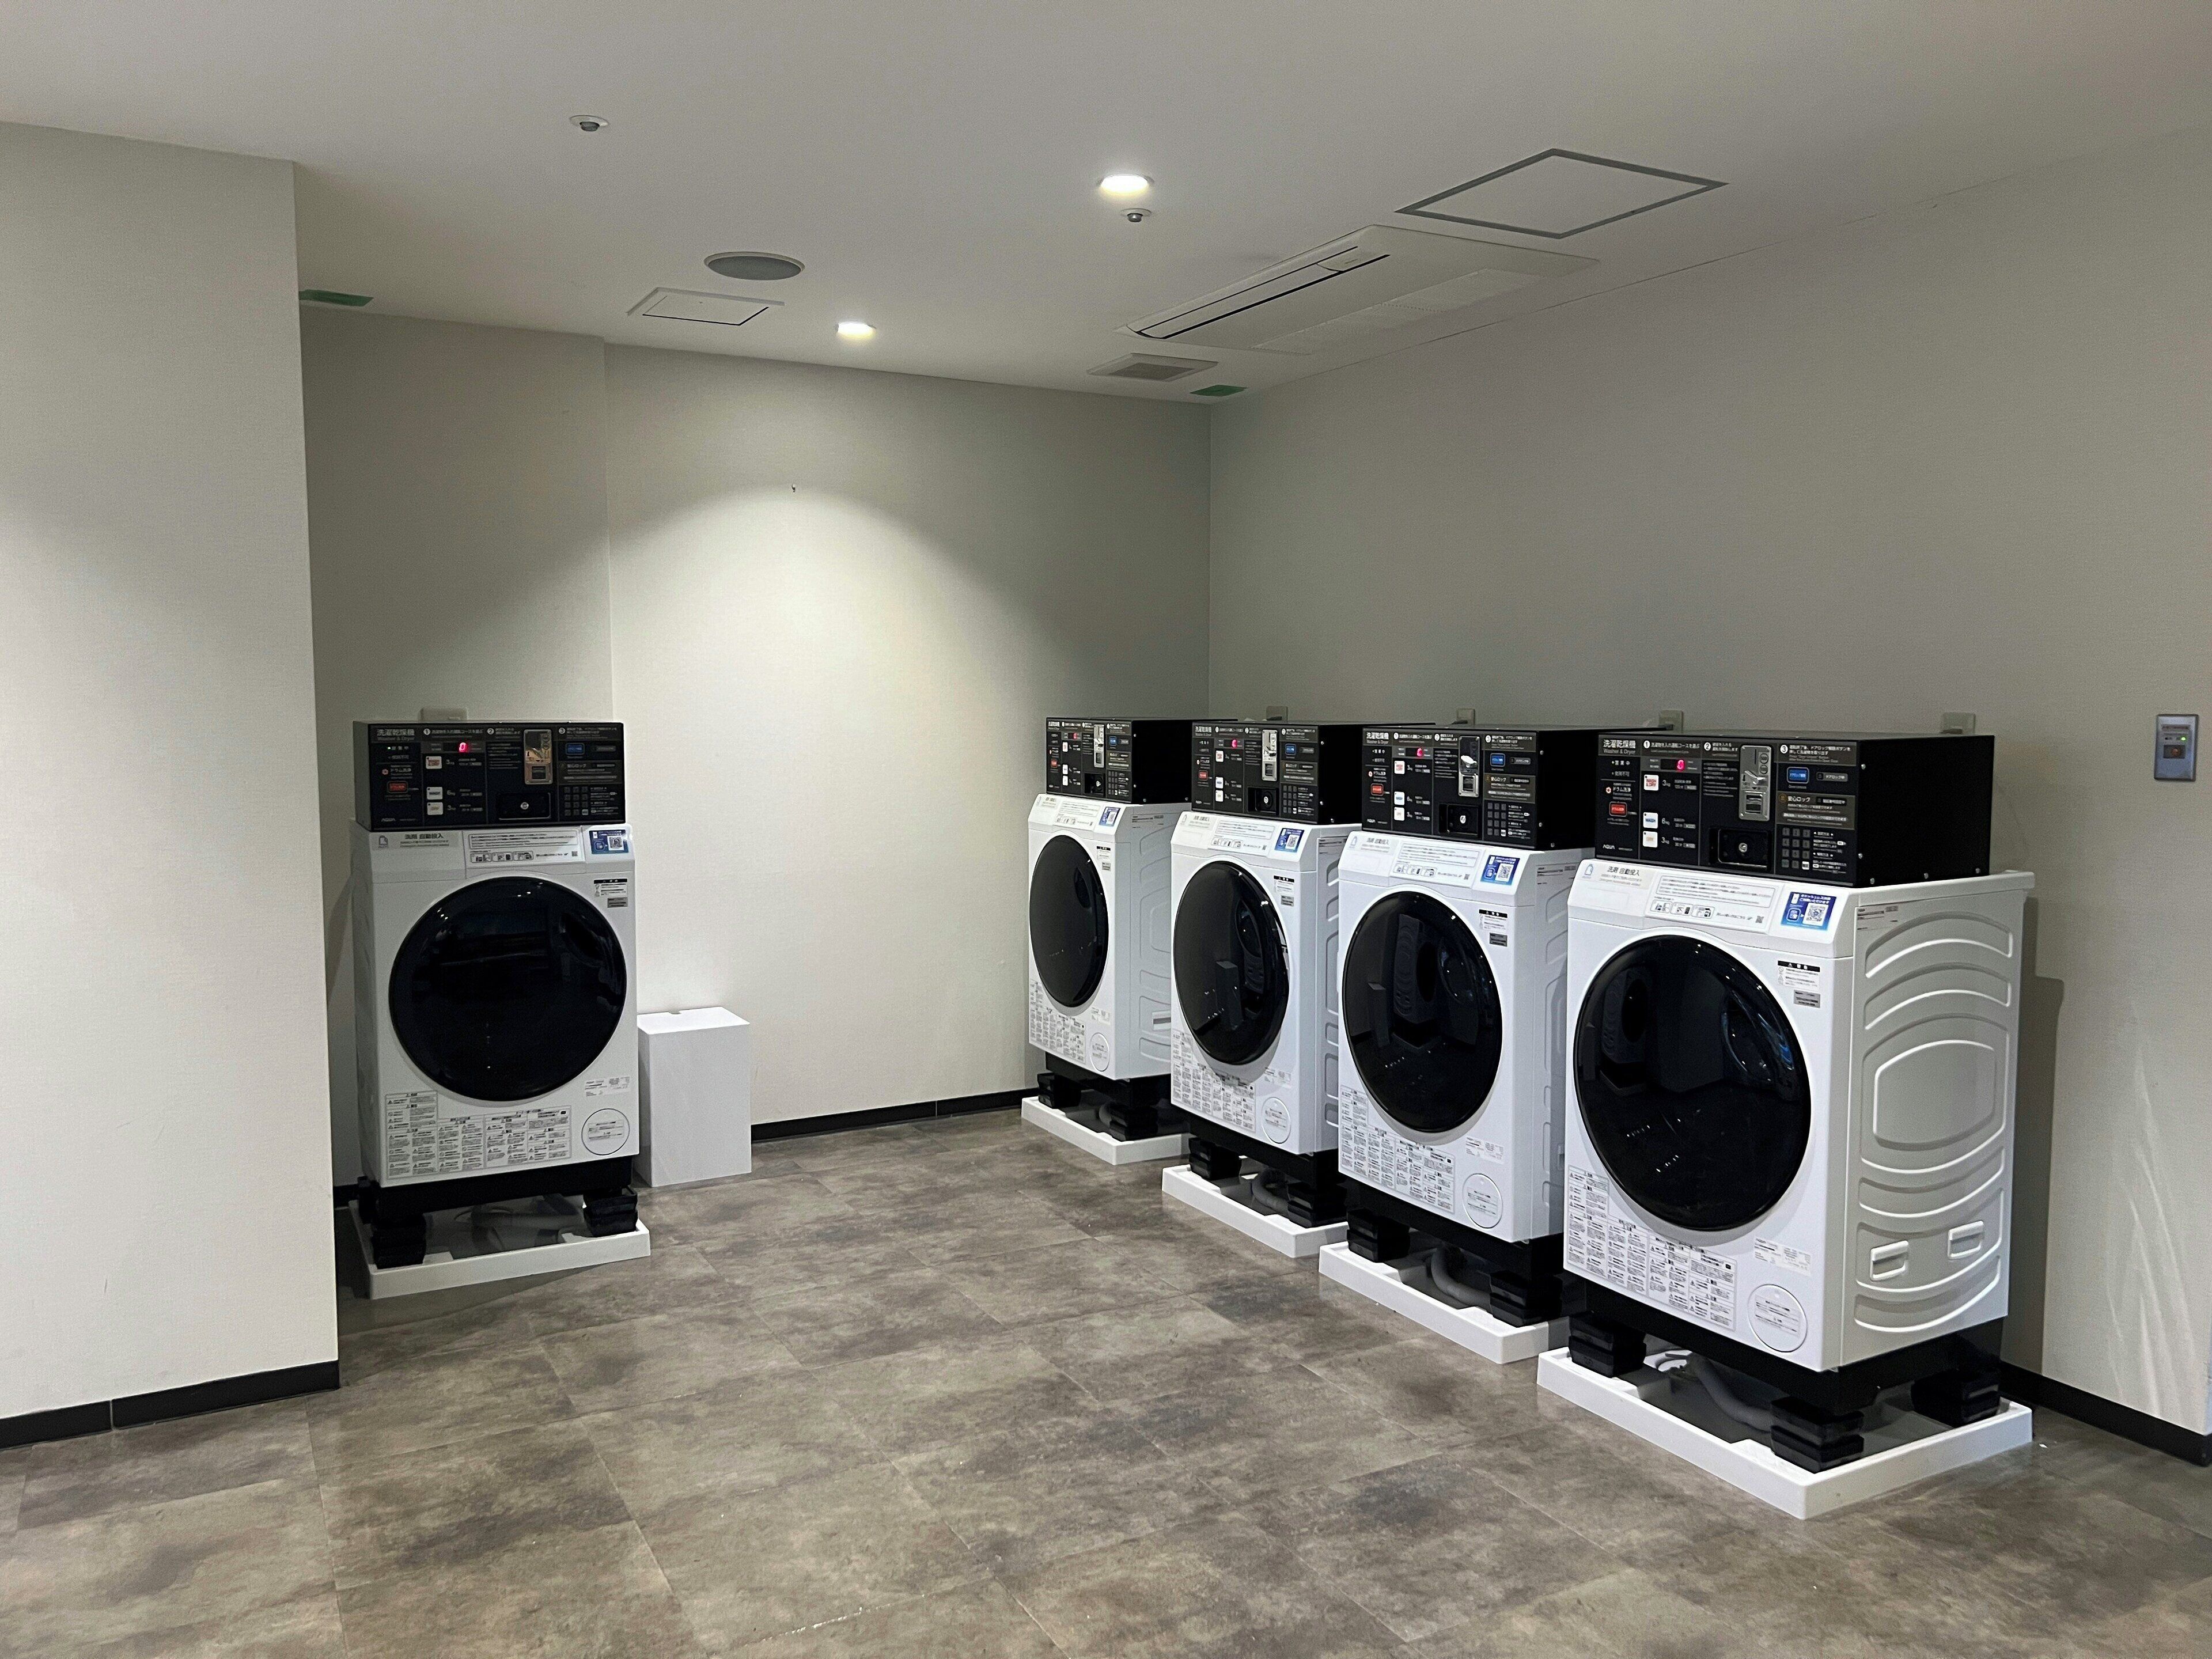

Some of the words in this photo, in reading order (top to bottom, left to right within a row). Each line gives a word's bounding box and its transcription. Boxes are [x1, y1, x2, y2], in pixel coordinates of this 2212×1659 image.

[459, 741, 468, 752] 0
[1603, 739, 1636, 748] 洗濯乾燥機
